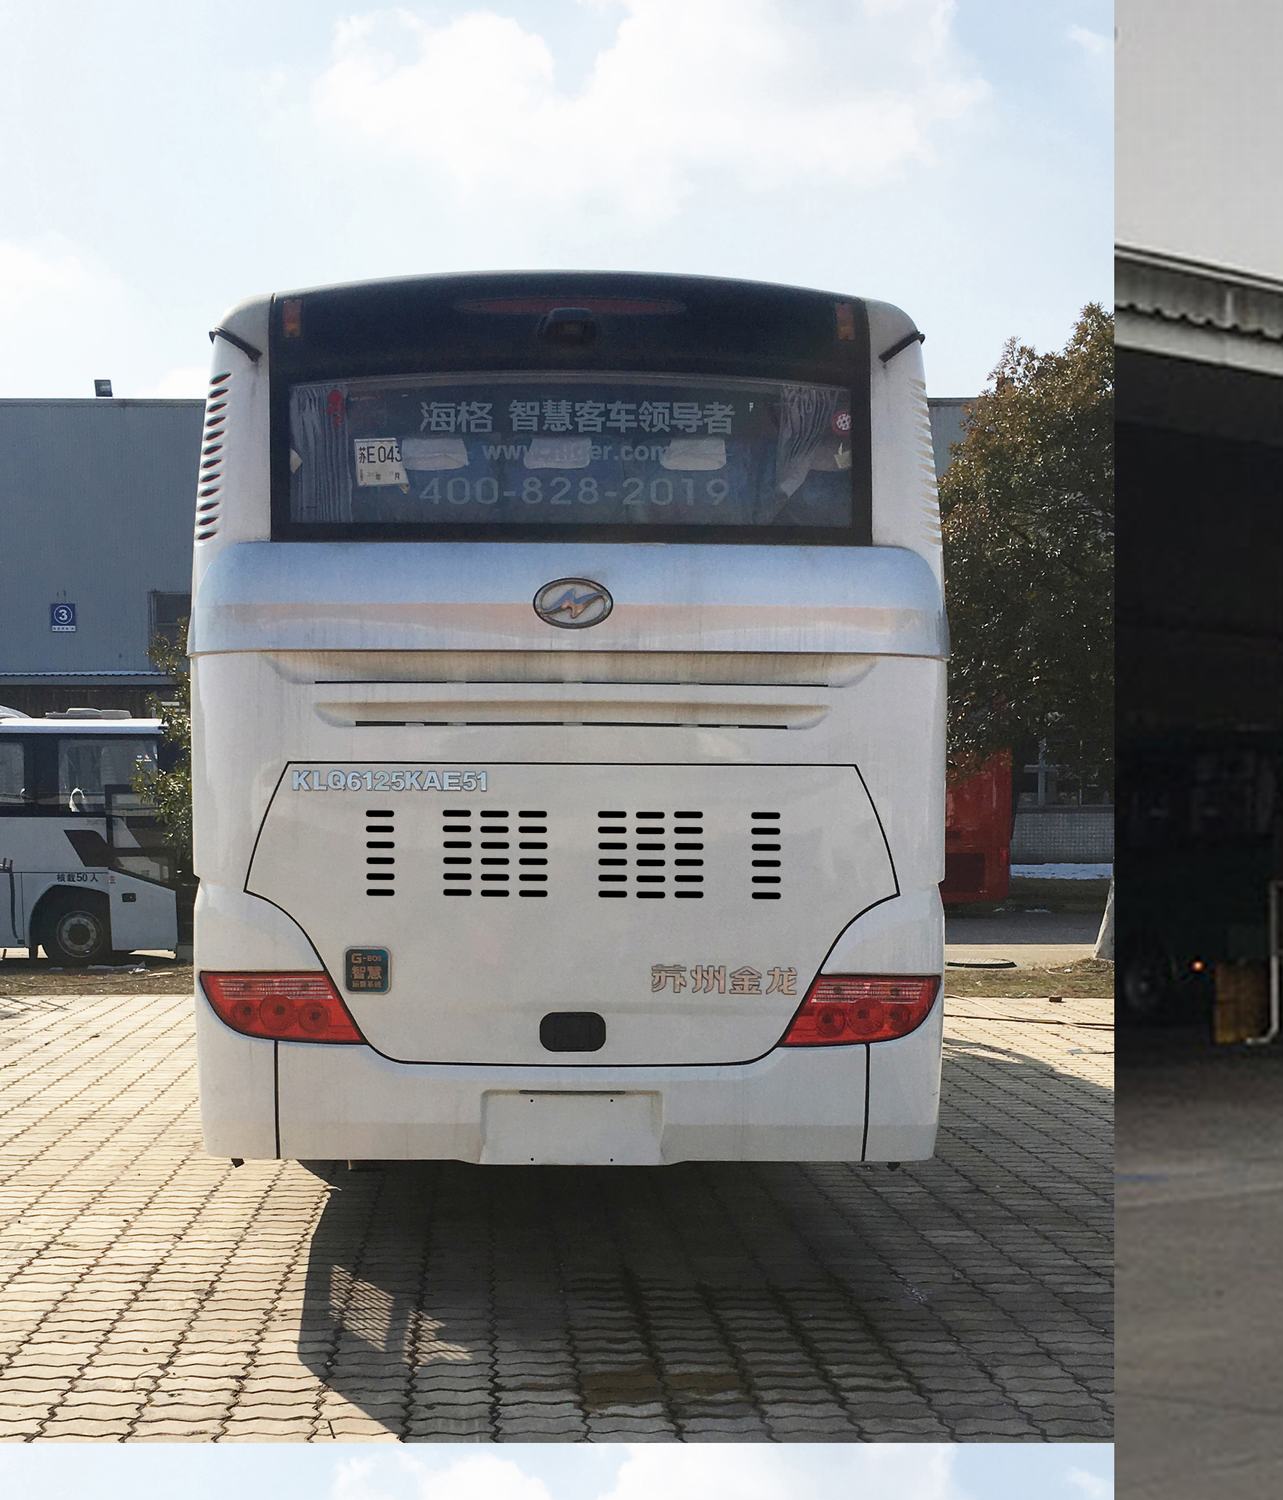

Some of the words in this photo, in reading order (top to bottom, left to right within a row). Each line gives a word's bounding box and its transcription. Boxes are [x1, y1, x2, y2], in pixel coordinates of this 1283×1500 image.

[420, 402, 493, 433] 海格
[509, 399, 735, 434] 智慧客车领导者
[420, 477, 729, 505] 400-828-2019
[292, 770, 488, 792] KLQ6125KAE51
[651, 964, 798, 995] 苏州金龙
